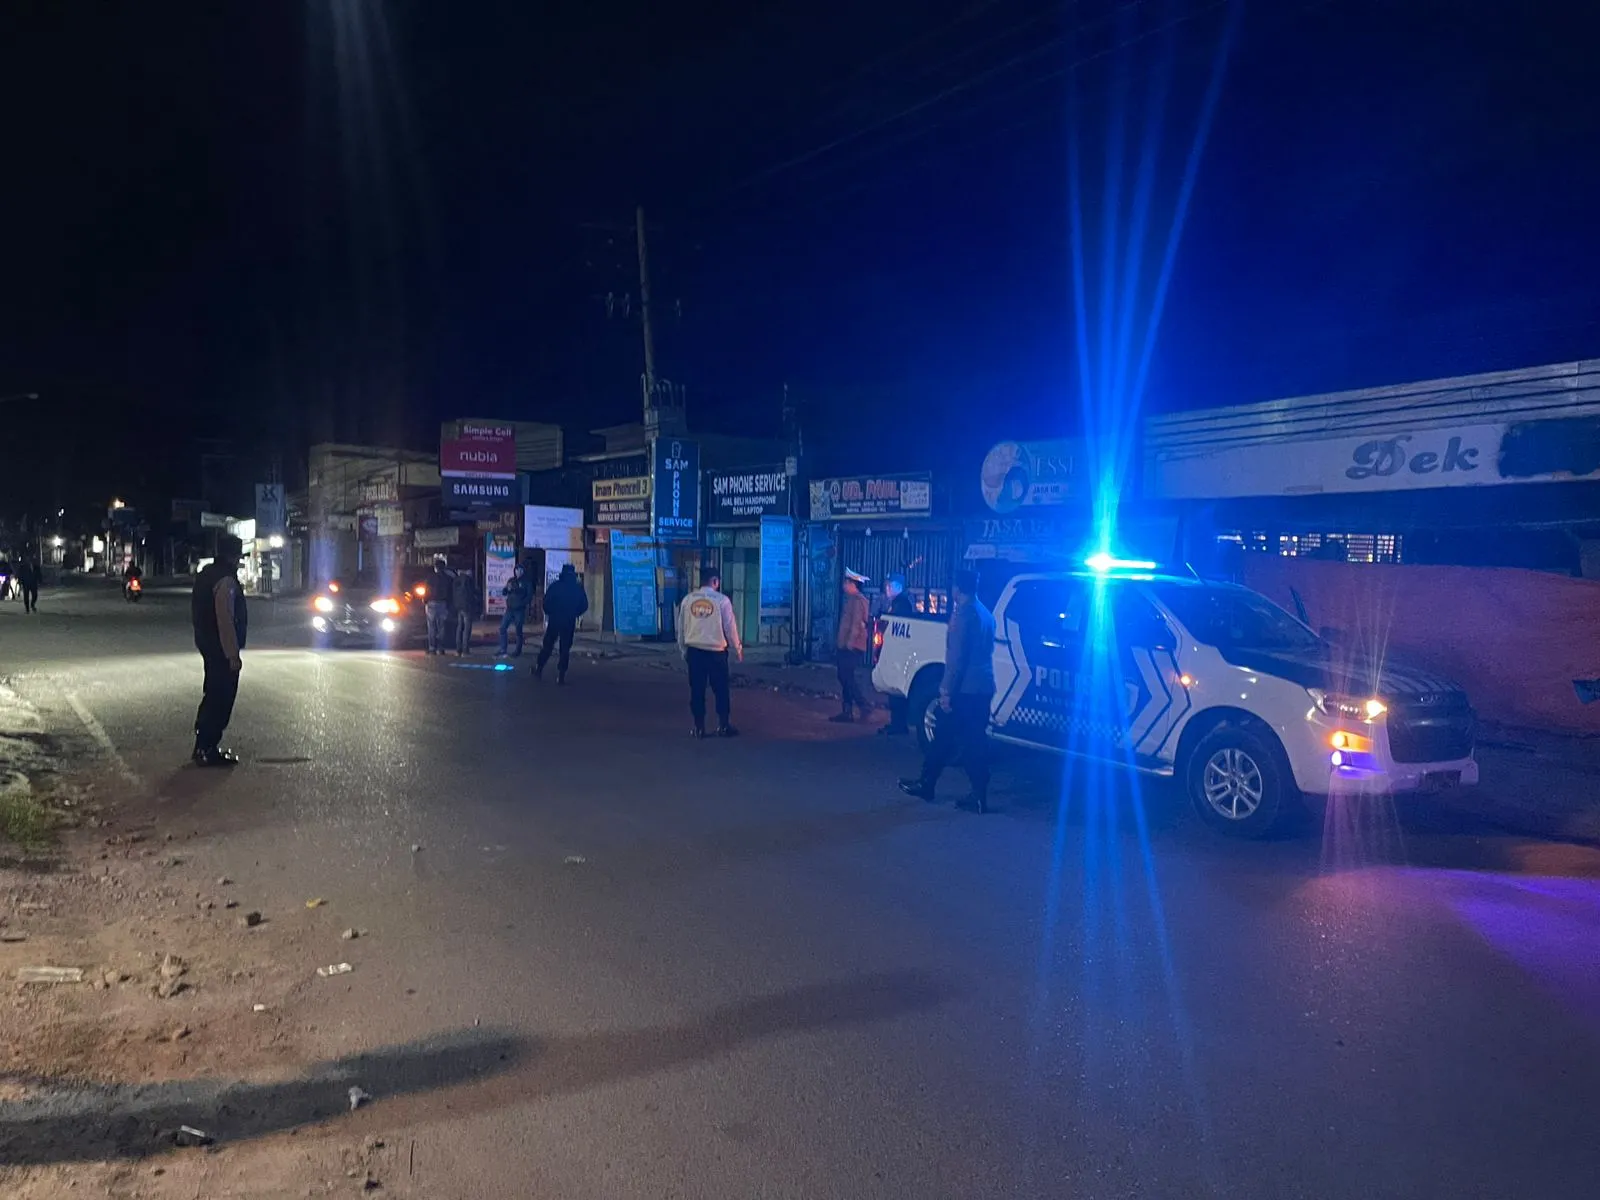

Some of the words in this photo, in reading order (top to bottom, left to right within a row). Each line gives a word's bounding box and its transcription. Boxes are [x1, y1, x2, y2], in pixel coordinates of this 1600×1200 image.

[463, 425, 493, 436] Simple
[460, 451, 498, 463] nubia
[1345, 434, 1479, 480] Dek
[665, 458, 689, 470] SAM
[453, 483, 509, 496] SAMSUNG
[713, 477, 728, 495] SAM
[729, 475, 754, 494] PHONE
[754, 472, 786, 493] SERVICE
[732, 506, 743, 516] DAN
[744, 505, 763, 515] LAPTOP
[659, 517, 693, 528] SERVICE
[892, 621, 911, 638] WAL
